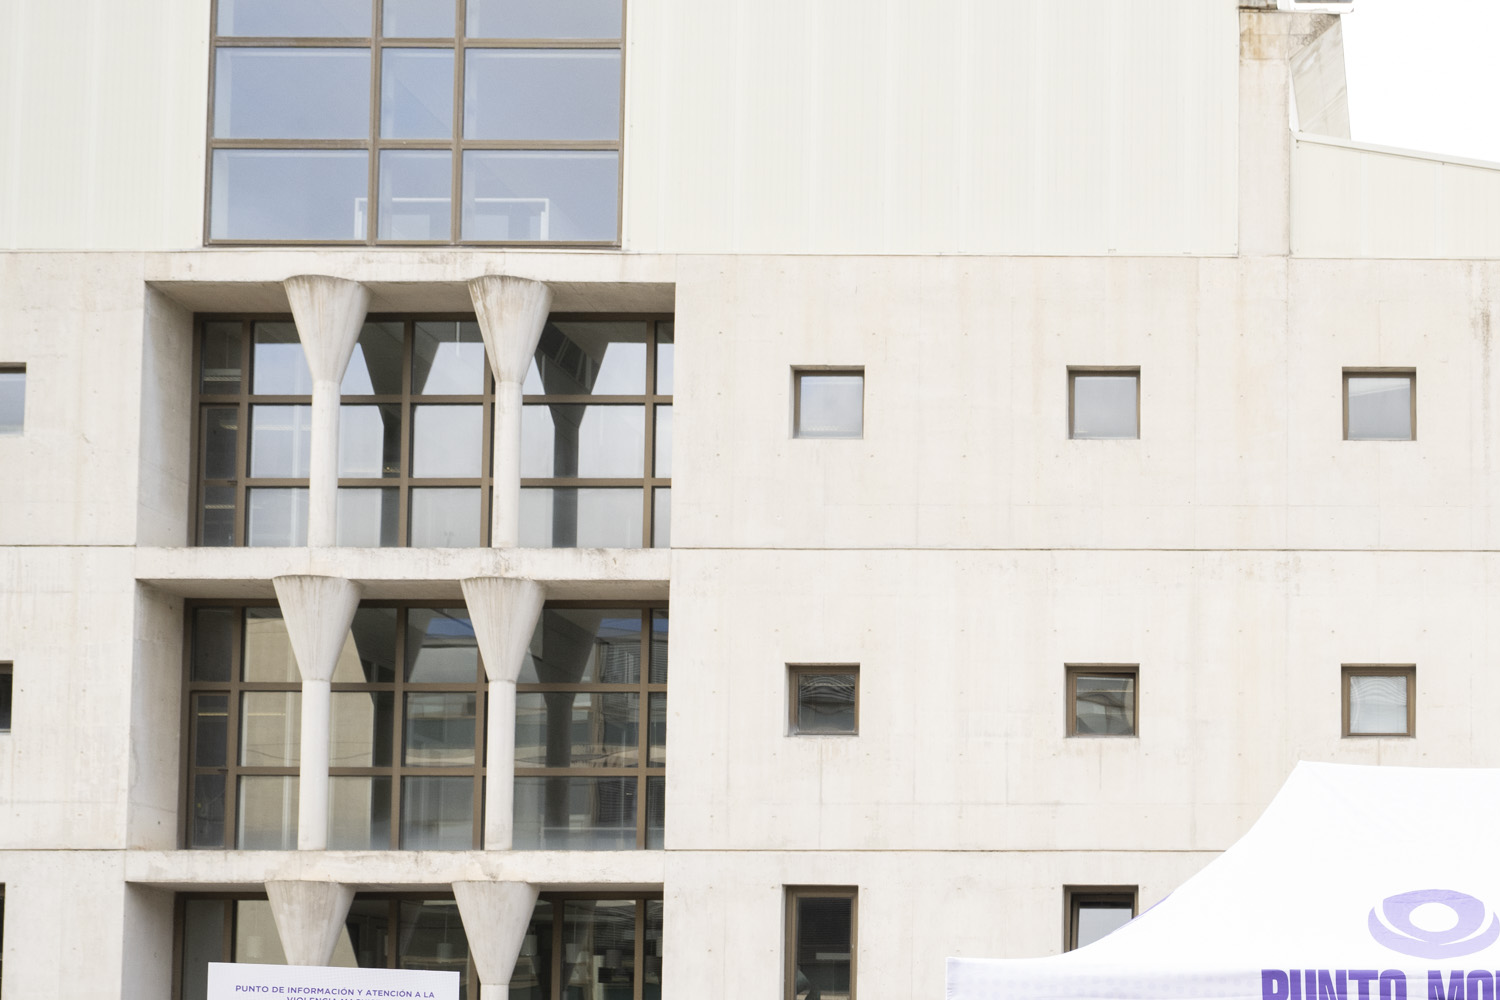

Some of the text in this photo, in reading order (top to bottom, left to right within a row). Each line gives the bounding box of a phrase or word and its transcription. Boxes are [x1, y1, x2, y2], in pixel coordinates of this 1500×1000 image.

[235, 985, 269, 993] PUNTO
[272, 986, 285, 994] DE
[287, 986, 354, 996] INFORMACIÓN
[366, 989, 412, 998] ATENCIÓN
